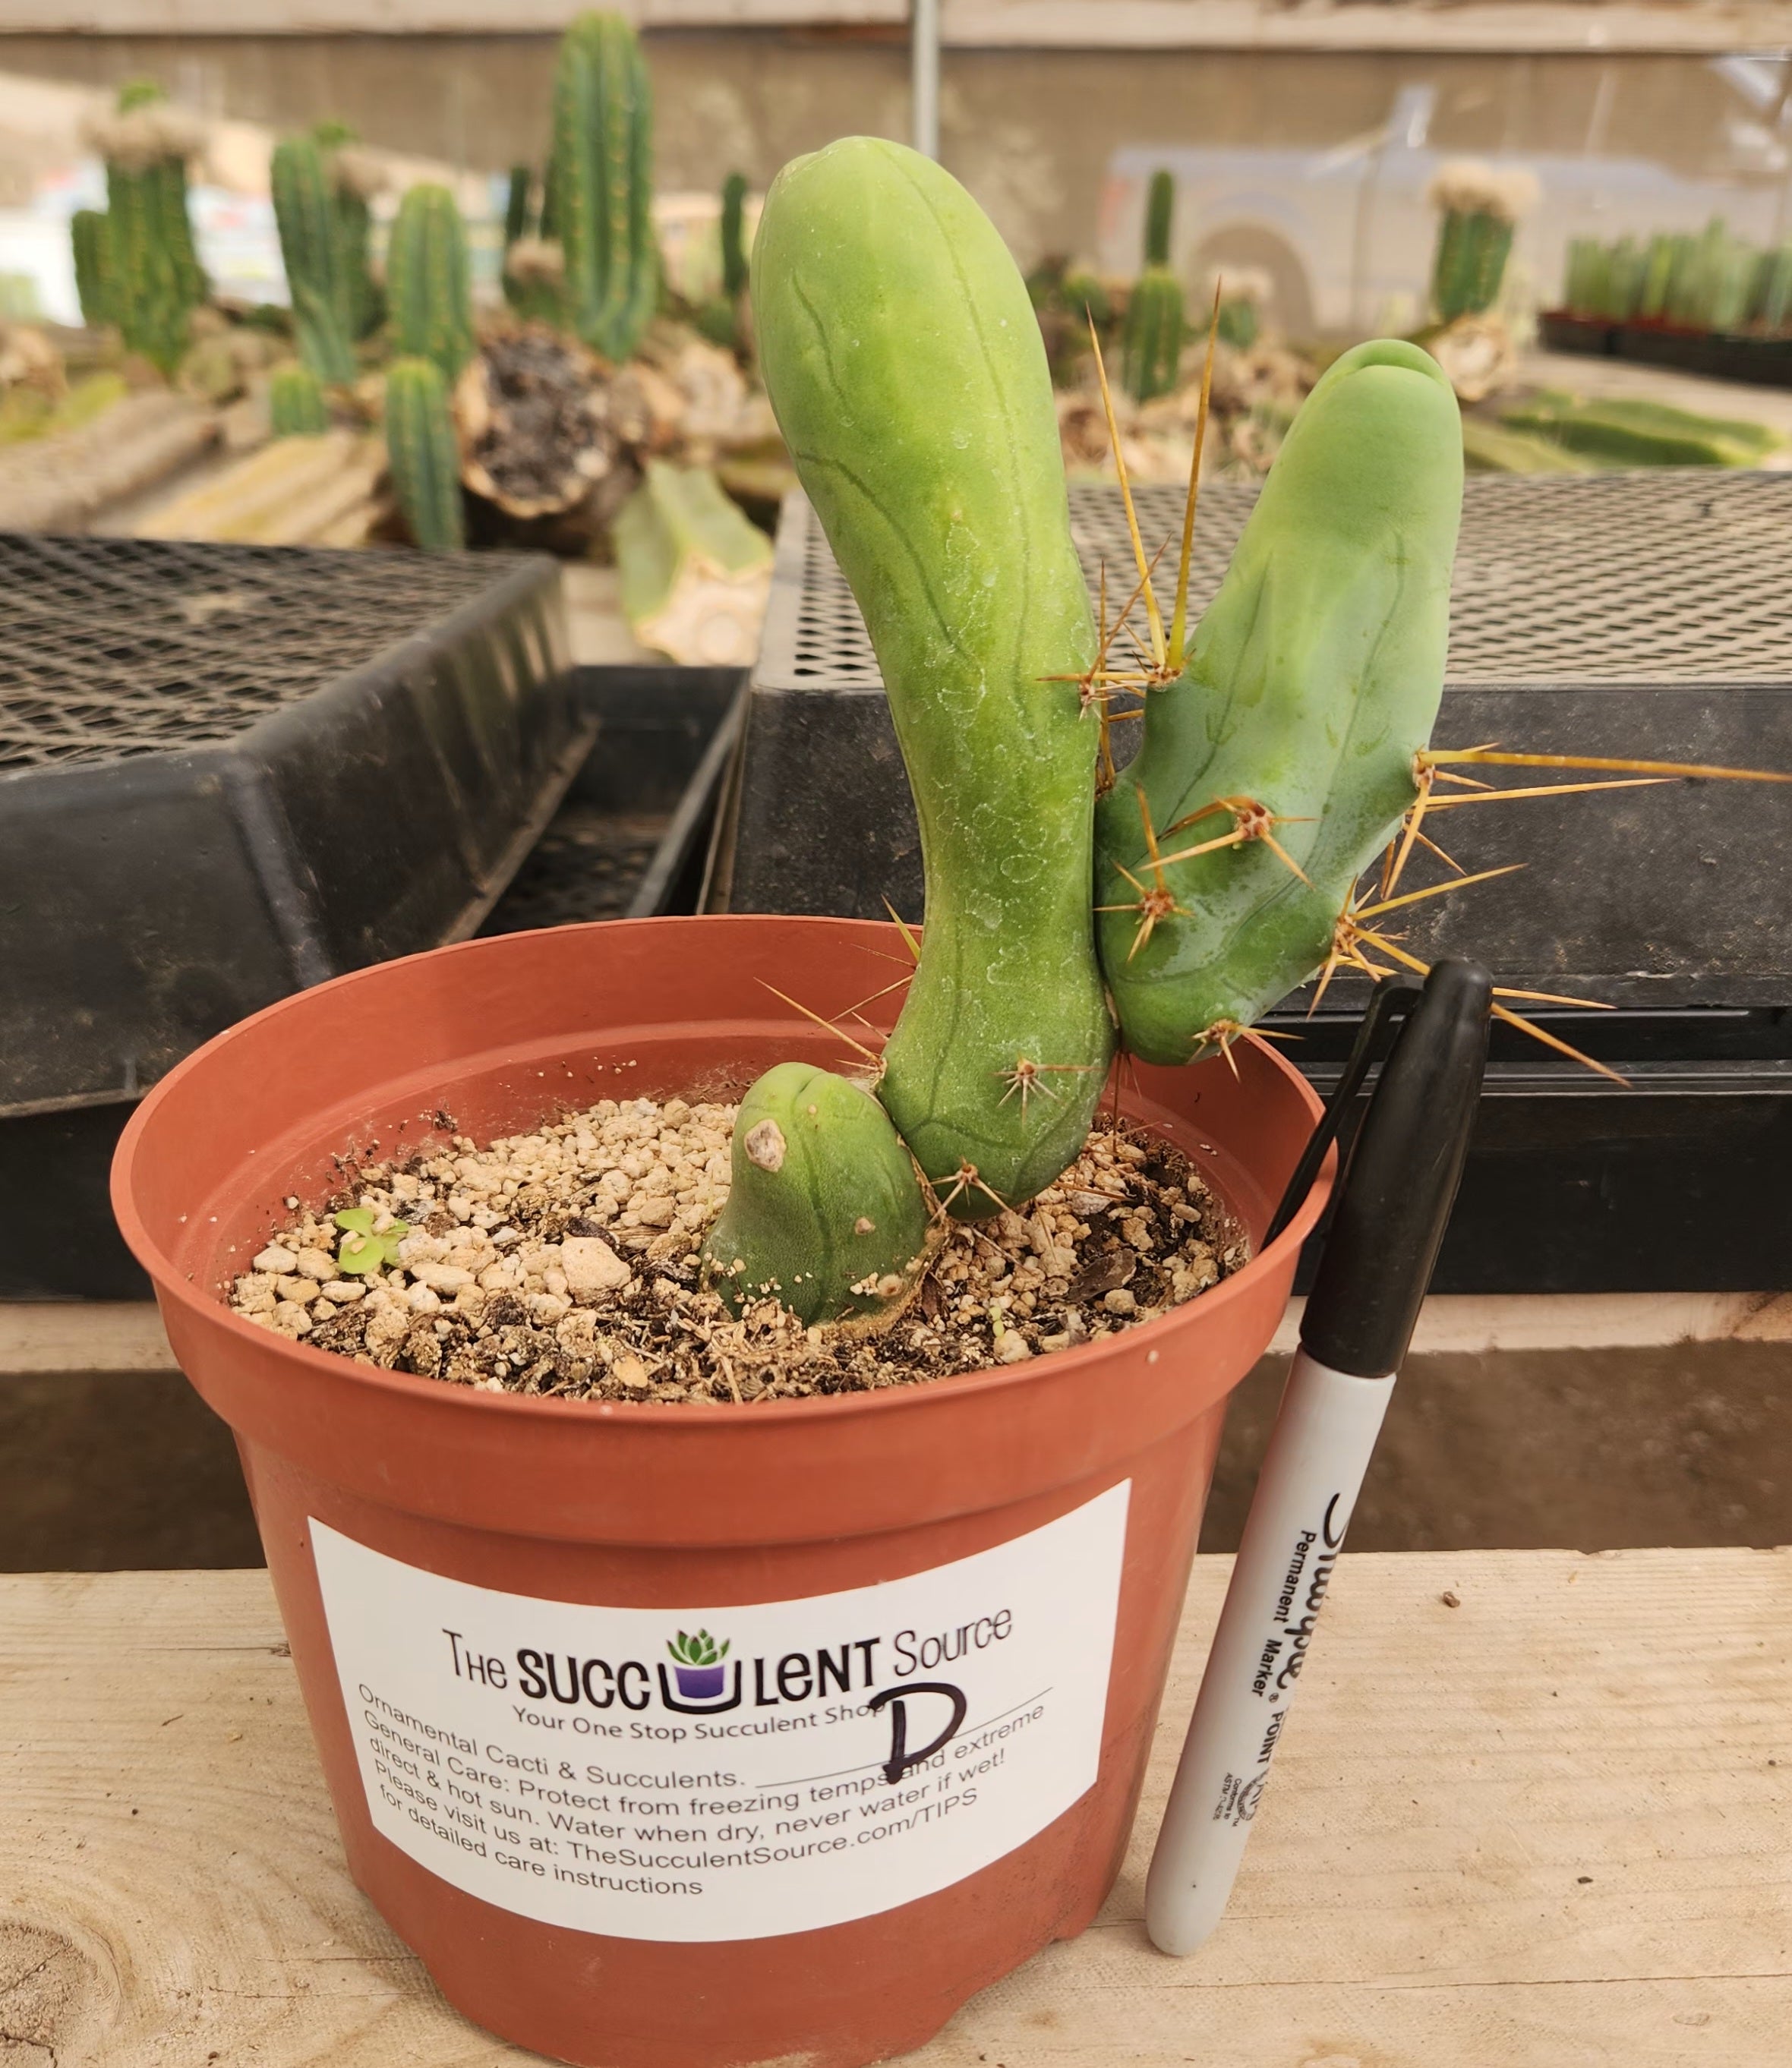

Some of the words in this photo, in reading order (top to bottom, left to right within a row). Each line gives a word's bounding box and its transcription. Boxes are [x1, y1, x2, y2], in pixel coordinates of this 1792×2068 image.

[1273, 1530, 1317, 1623] Permanent
[893, 1609, 1013, 1677] Source
[1251, 1639, 1282, 1698] Marker
[358, 1683, 478, 1756] Ornamental
[487, 1744, 548, 1776] Cacti
[559, 1761, 577, 1780] &
[587, 1765, 746, 1790] Succulents.
[364, 1709, 440, 1766] General
[448, 1756, 510, 1792] Care:
[519, 1779, 610, 1813] Protect
[620, 1795, 680, 1817] from
[690, 1792, 800, 1817] freezing
[809, 1773, 889, 1802] temps
[902, 1750, 945, 1780] and
[954, 1703, 1045, 1759] extreme
[513, 1704, 565, 1731] Your
[573, 1717, 623, 1738] One
[631, 1722, 686, 1744] Stop
[696, 1713, 817, 1739] Succulent
[825, 1703, 885, 1724] Shop
[869, 1682, 967, 1785] D
[1257, 1711, 1284, 1764] POINT
[370, 1736, 421, 1780] direct
[427, 1769, 440, 1790] &
[448, 1777, 482, 1809] hot
[491, 1802, 540, 1826] sun.
[548, 1811, 625, 1840] Water
[635, 1826, 707, 1843] when
[718, 1823, 765, 1843] dry,
[776, 1810, 851, 1836] never
[860, 1786, 929, 1817] water
[937, 1773, 954, 1793] if
[960, 1748, 1005, 1783] wet!
[376, 1758, 438, 1811] Please
[444, 1804, 487, 1834] visit
[494, 1825, 521, 1845] us
[530, 1835, 559, 1855] at:
[567, 1788, 978, 1869] TheSucculentSource.com/TIPS
[1223, 1773, 1234, 1795] ASTM
[1226, 1778, 1242, 1811] Conforms
[380, 1784, 403, 1812] for
[409, 1799, 487, 1858] detailed
[495, 1849, 546, 1877] care
[554, 1864, 703, 1896] instructions
